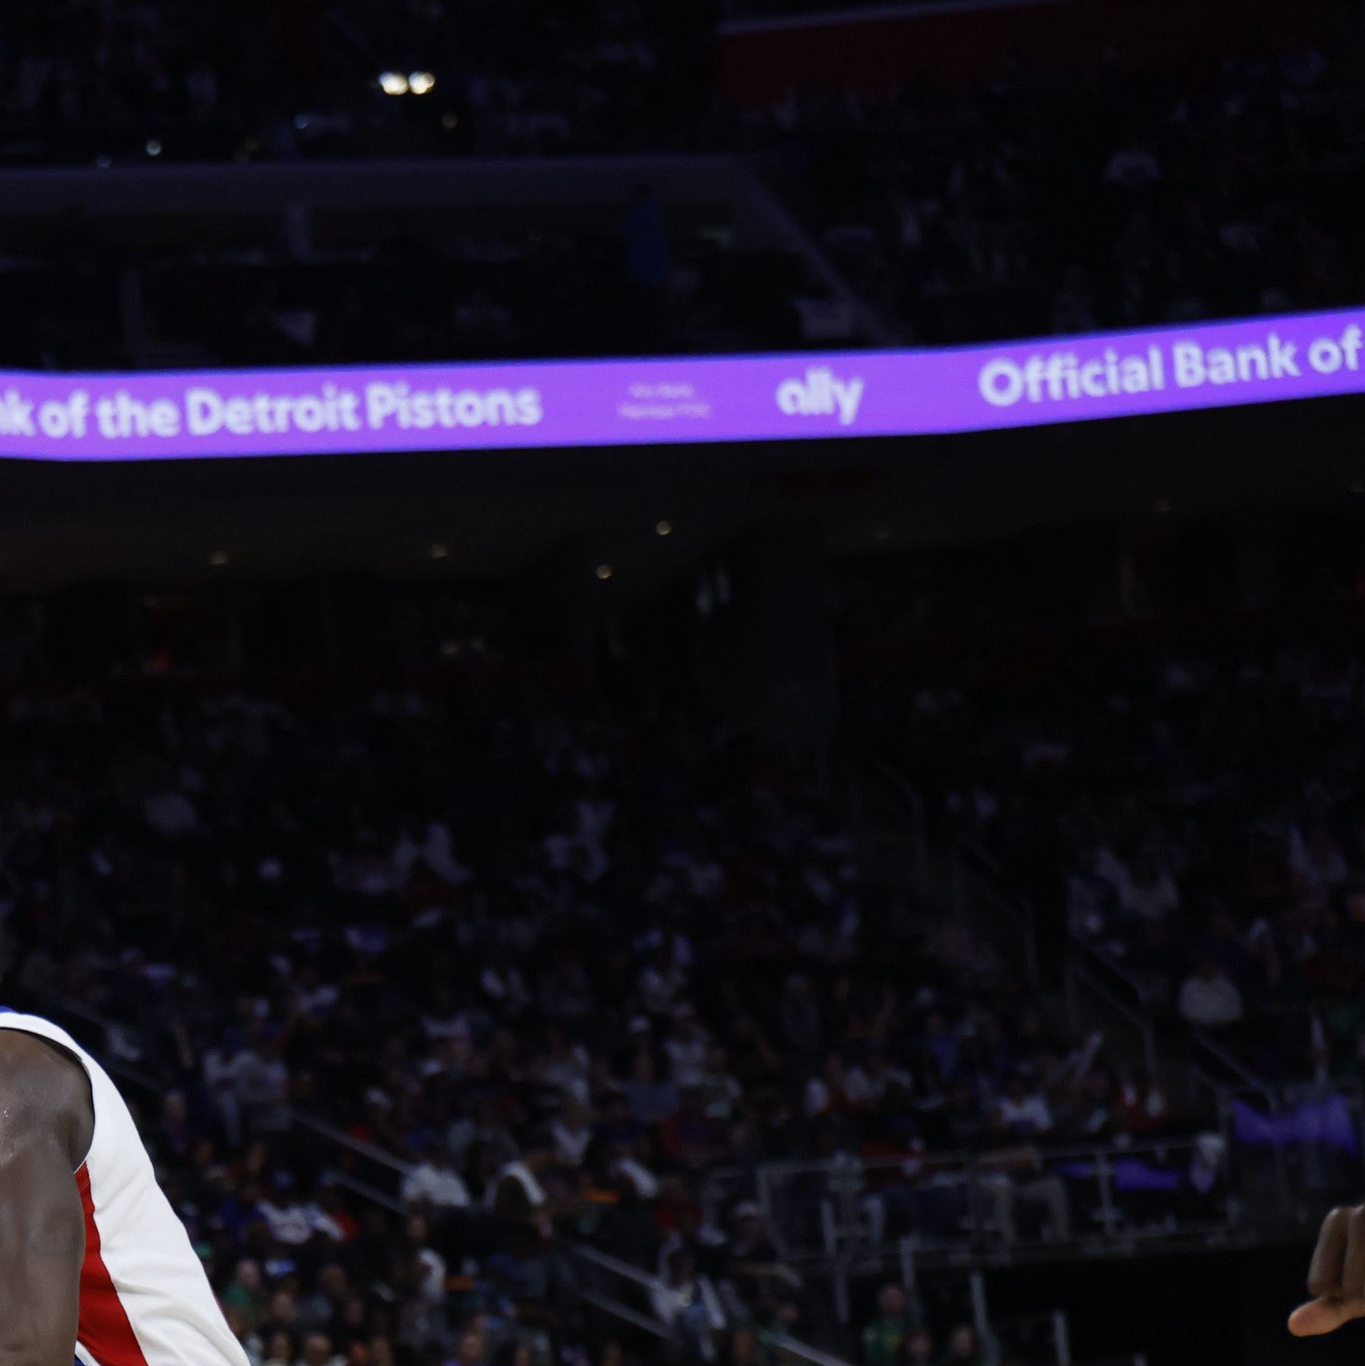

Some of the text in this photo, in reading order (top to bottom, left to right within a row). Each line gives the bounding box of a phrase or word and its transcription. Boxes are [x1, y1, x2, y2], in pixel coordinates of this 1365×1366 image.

[776, 364, 863, 426] ally
[978, 321, 1363, 408] Official Bank of
[38, 390, 87, 439] of
[97, 390, 179, 438] the
[185, 381, 362, 436] Detroit
[365, 379, 542, 430] Pistons
